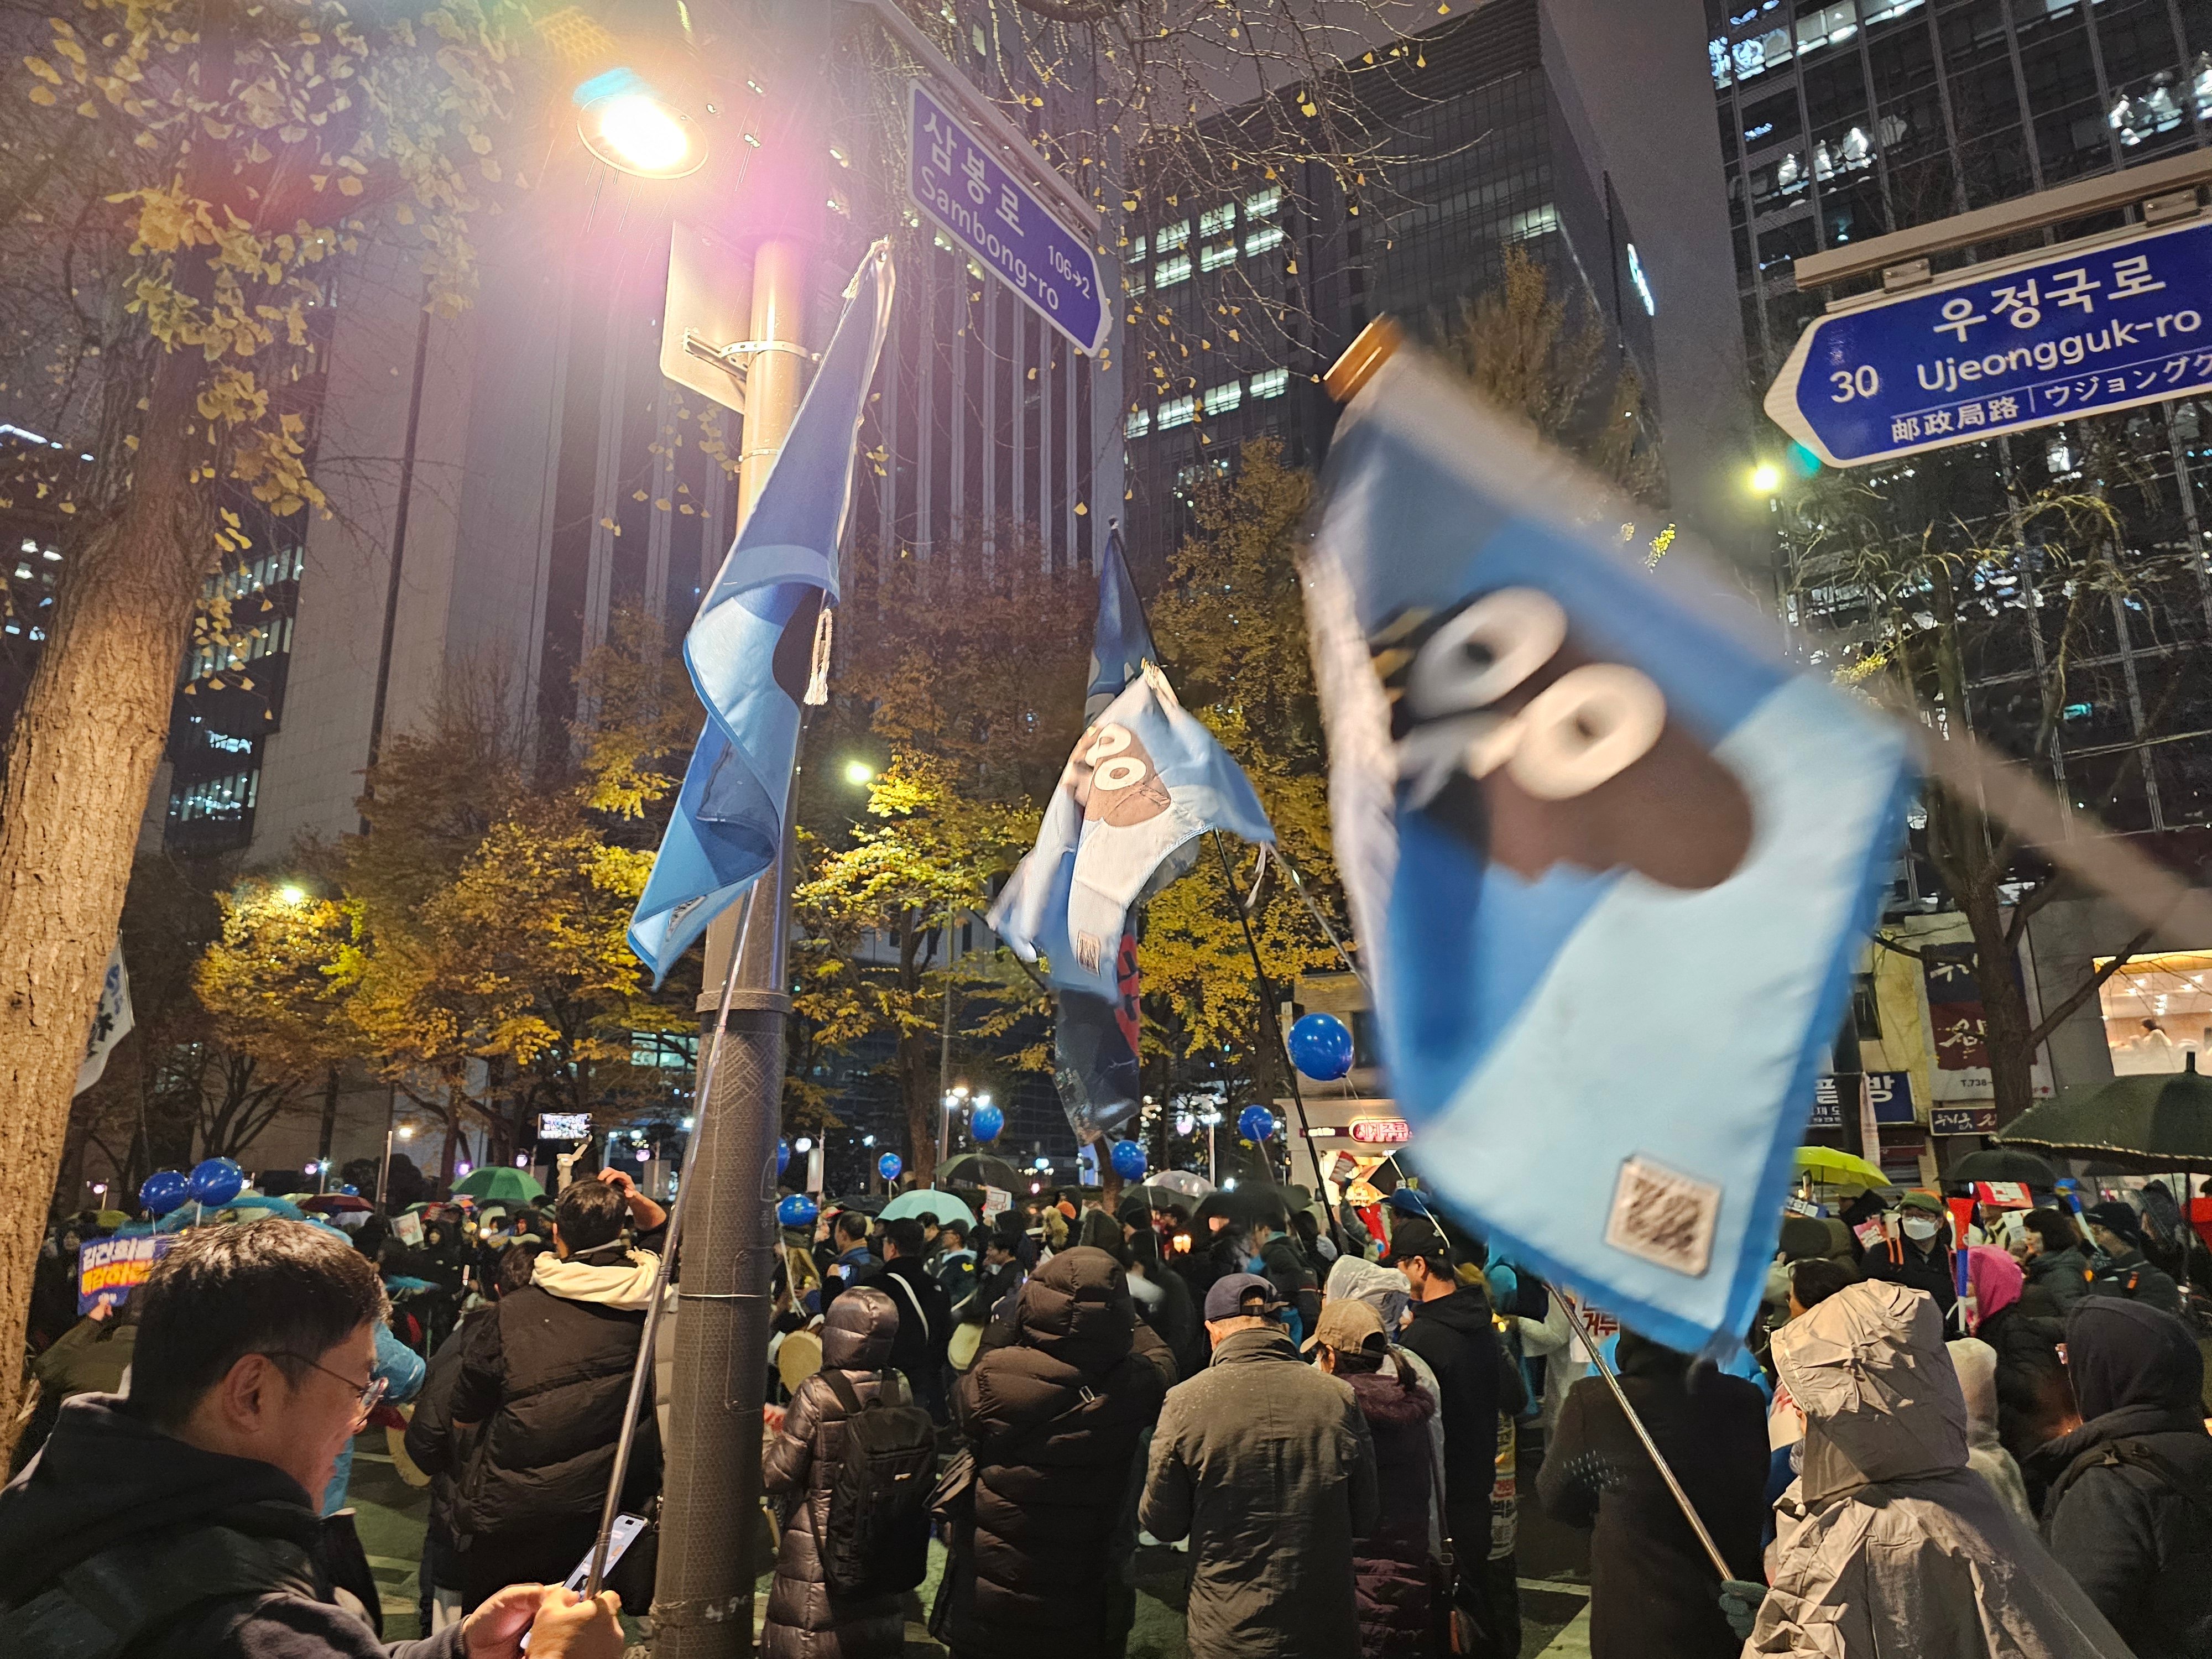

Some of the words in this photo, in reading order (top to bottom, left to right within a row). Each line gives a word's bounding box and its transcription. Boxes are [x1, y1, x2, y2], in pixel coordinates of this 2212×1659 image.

[924, 112, 1024, 237] 삼봉로
[921, 166, 1059, 310] Sambong-ro
[1933, 255, 2166, 342] 우정국로
[1829, 364, 1880, 403] 30
[1917, 310, 2201, 392] Ujeongguk-ro
